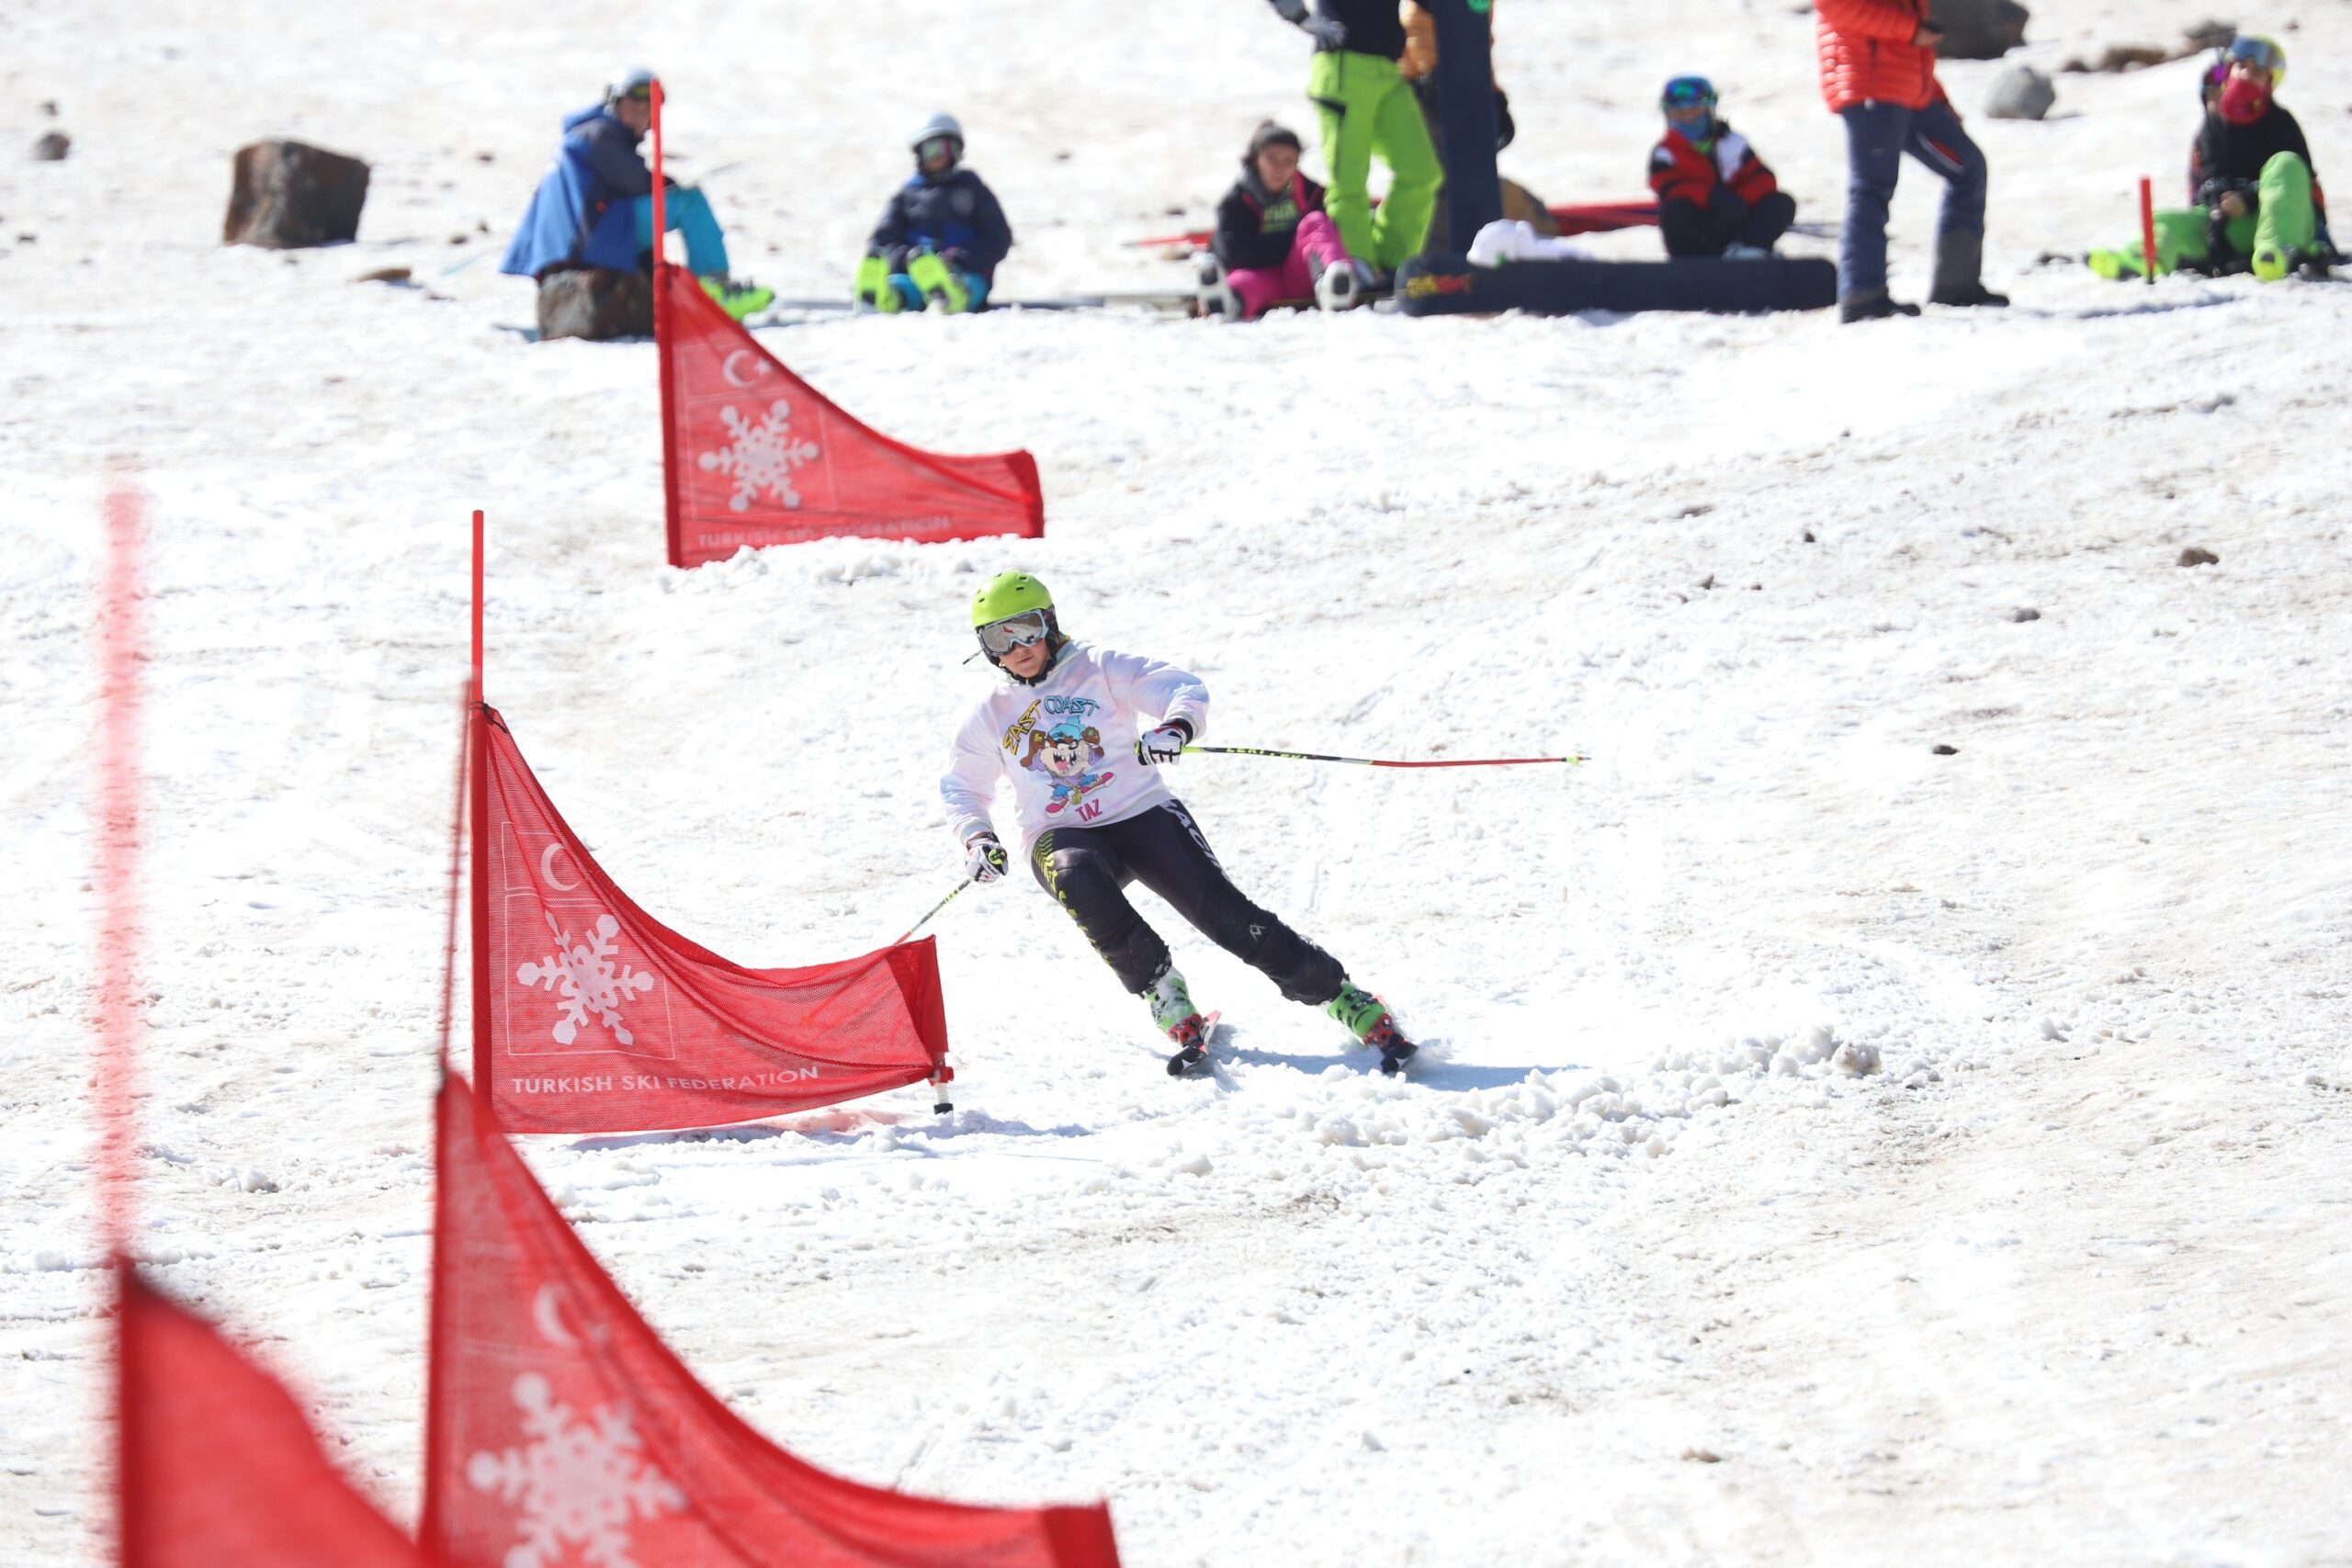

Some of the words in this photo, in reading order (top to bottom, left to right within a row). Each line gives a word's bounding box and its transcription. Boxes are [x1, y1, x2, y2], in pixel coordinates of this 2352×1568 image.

[698, 530, 780, 549] TURKISH
[1002, 699, 1042, 756] EAST
[1044, 694, 1101, 716] COAST
[1075, 798, 1102, 822] TAZ
[512, 1076, 613, 1094] TURKISH
[621, 1075, 662, 1090] SKI
[667, 1066, 820, 1090] FEDERATION
